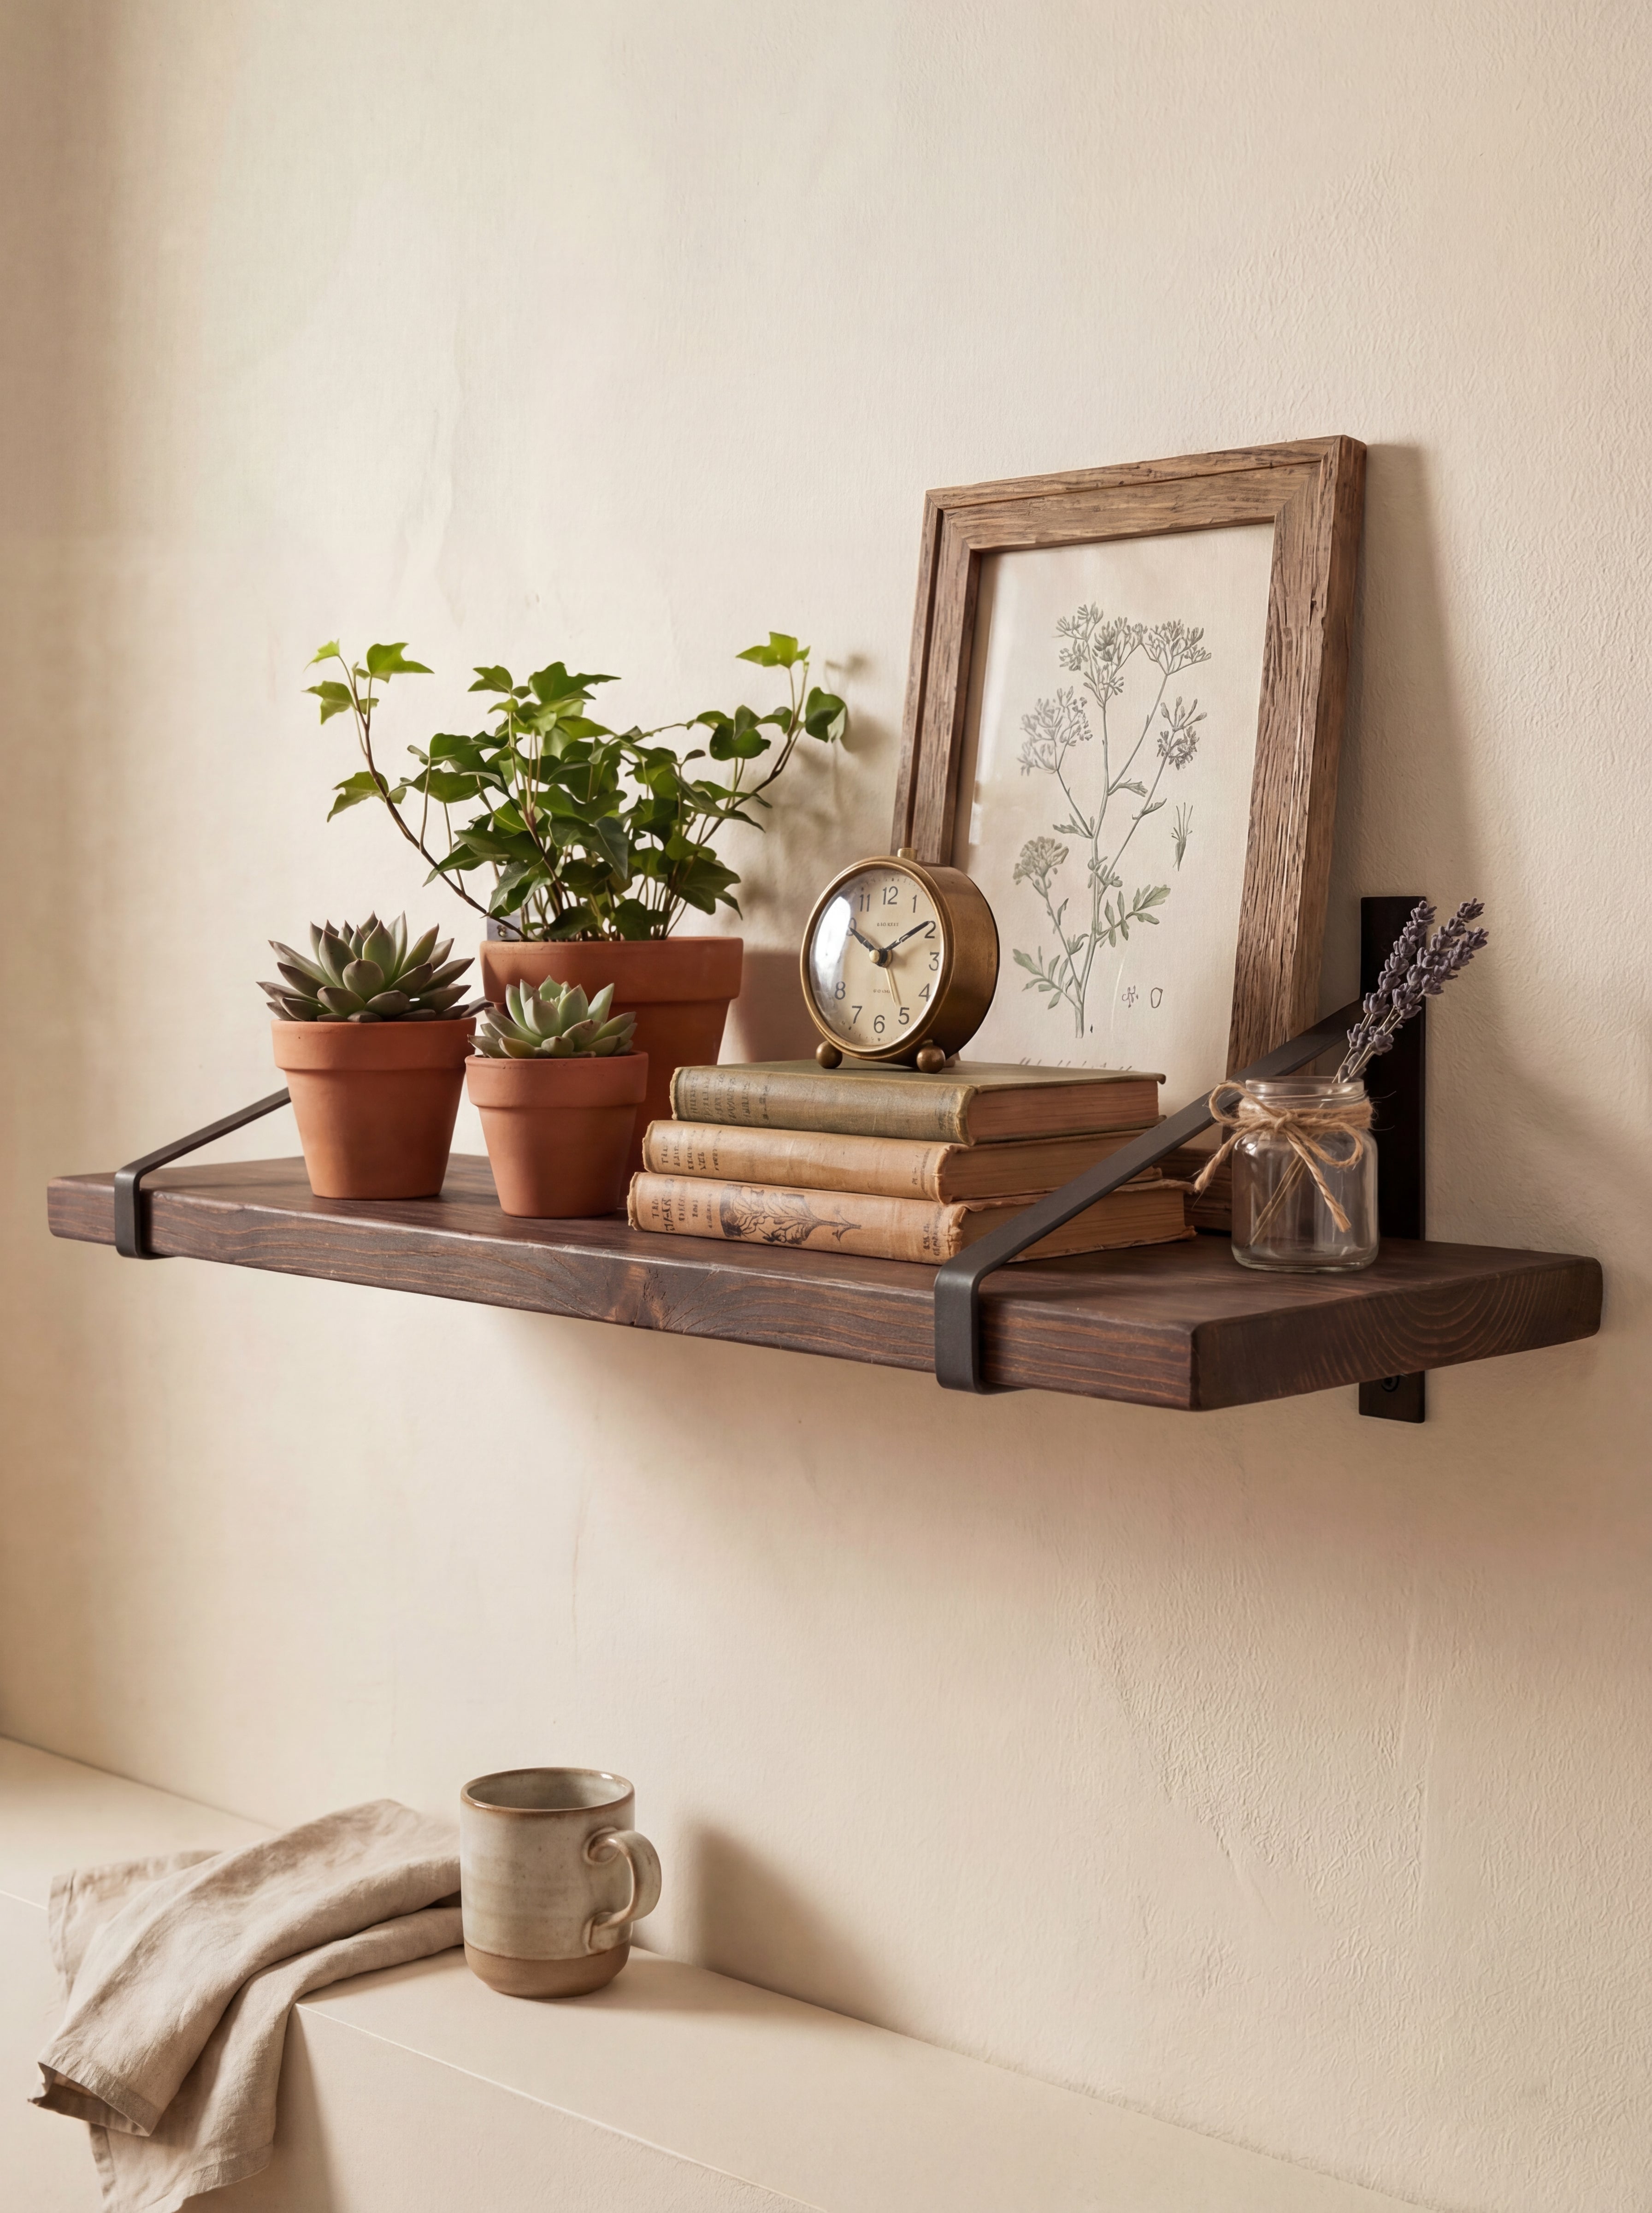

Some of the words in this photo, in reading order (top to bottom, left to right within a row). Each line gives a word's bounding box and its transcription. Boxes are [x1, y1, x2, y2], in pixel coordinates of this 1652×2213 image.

[859, 893, 871, 912] 11
[882, 886, 898, 905] 12
[912, 894, 918, 913] 1
[924, 920, 937, 939] 2
[928, 952, 939, 971] 3
[834, 981, 846, 1000] 8
[918, 983, 931, 1002] 4
[851, 1005, 862, 1024] 7
[897, 1007, 910, 1025] 5
[873, 1015, 885, 1034] 6
